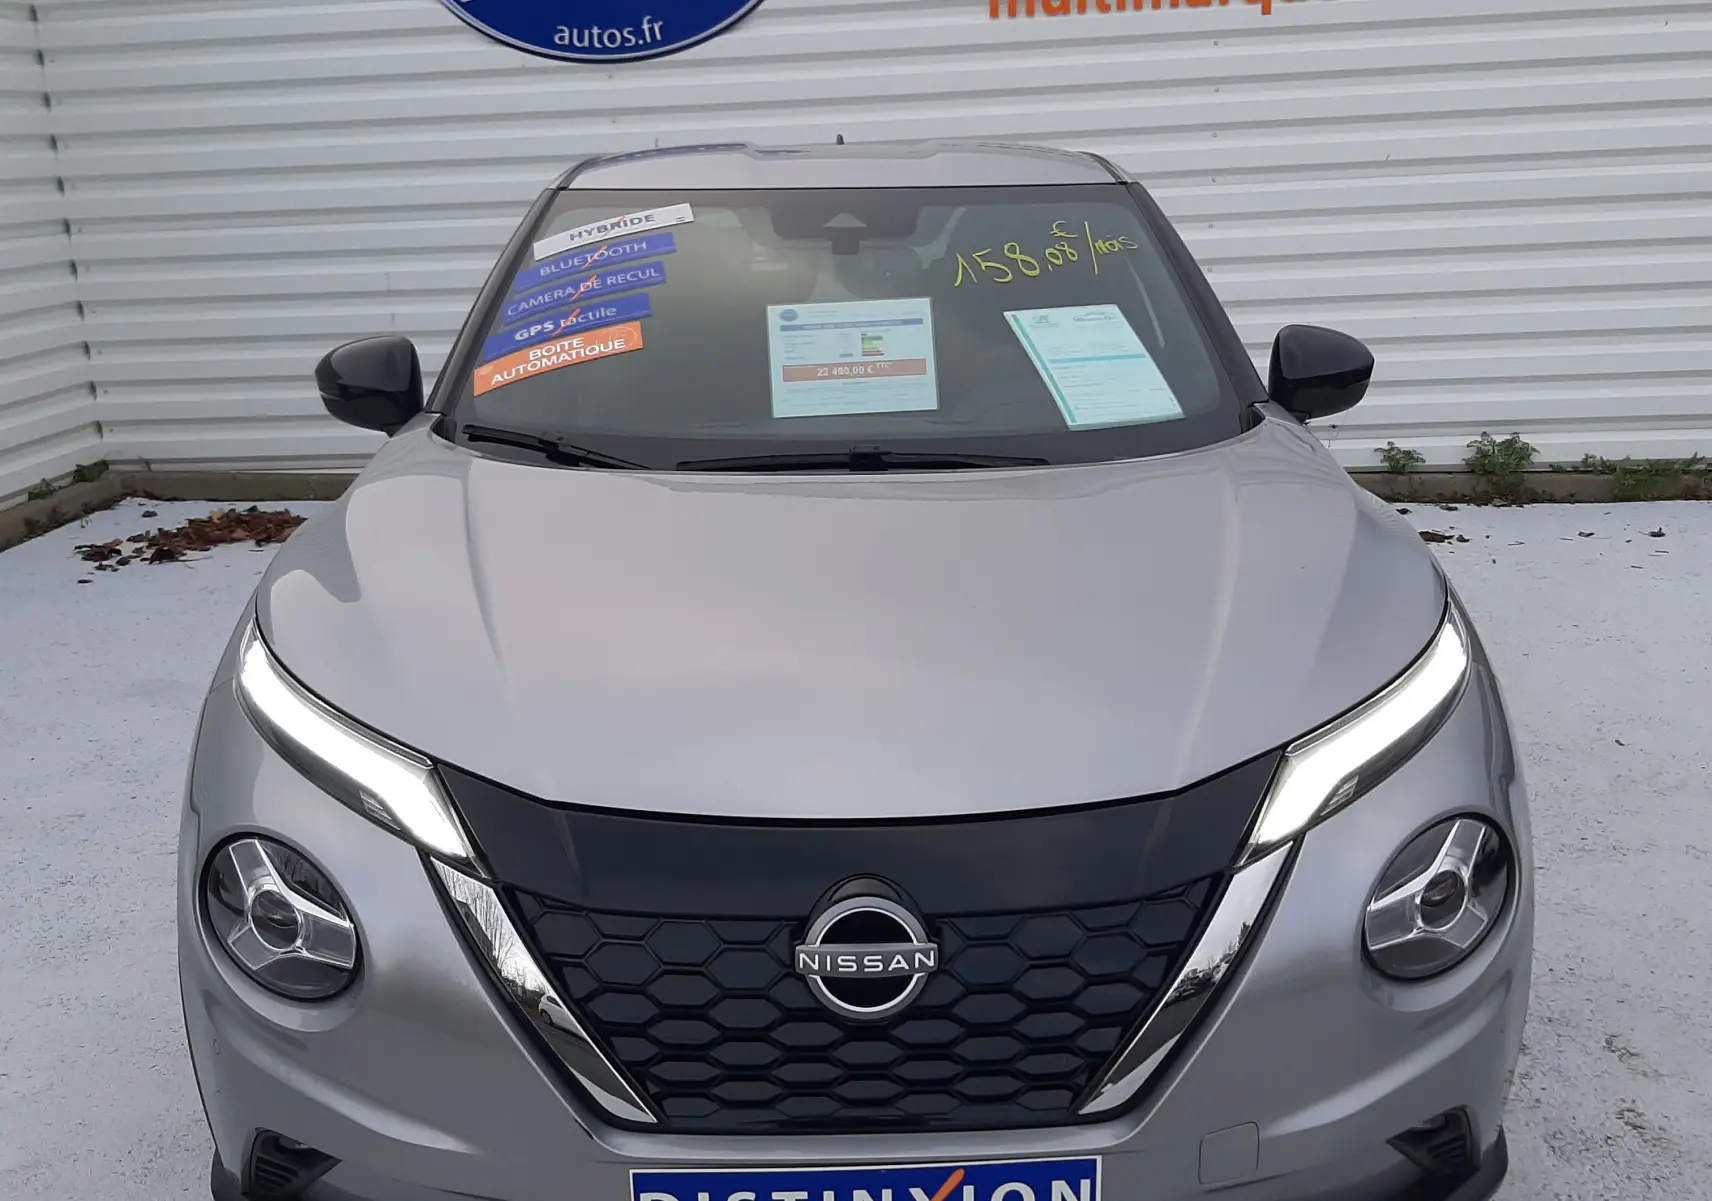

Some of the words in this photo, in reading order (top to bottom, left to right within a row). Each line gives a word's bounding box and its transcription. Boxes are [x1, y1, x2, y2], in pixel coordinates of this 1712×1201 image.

[554, 16, 664, 48] autos.fr
[569, 213, 656, 241] HYBRIDE
[540, 242, 648, 276] BLUETOOTH
[507, 287, 576, 316] CAMERA
[579, 278, 602, 292] DE
[607, 268, 660, 287] RECUL
[514, 320, 555, 341] GPS
[560, 305, 618, 327] tactile
[491, 338, 627, 385] AUTOMATIQUE
[529, 337, 585, 361] BOITE
[817, 367, 829, 377] 22
[867, 365, 875, 374] €
[799, 950, 935, 972] NISSAN
